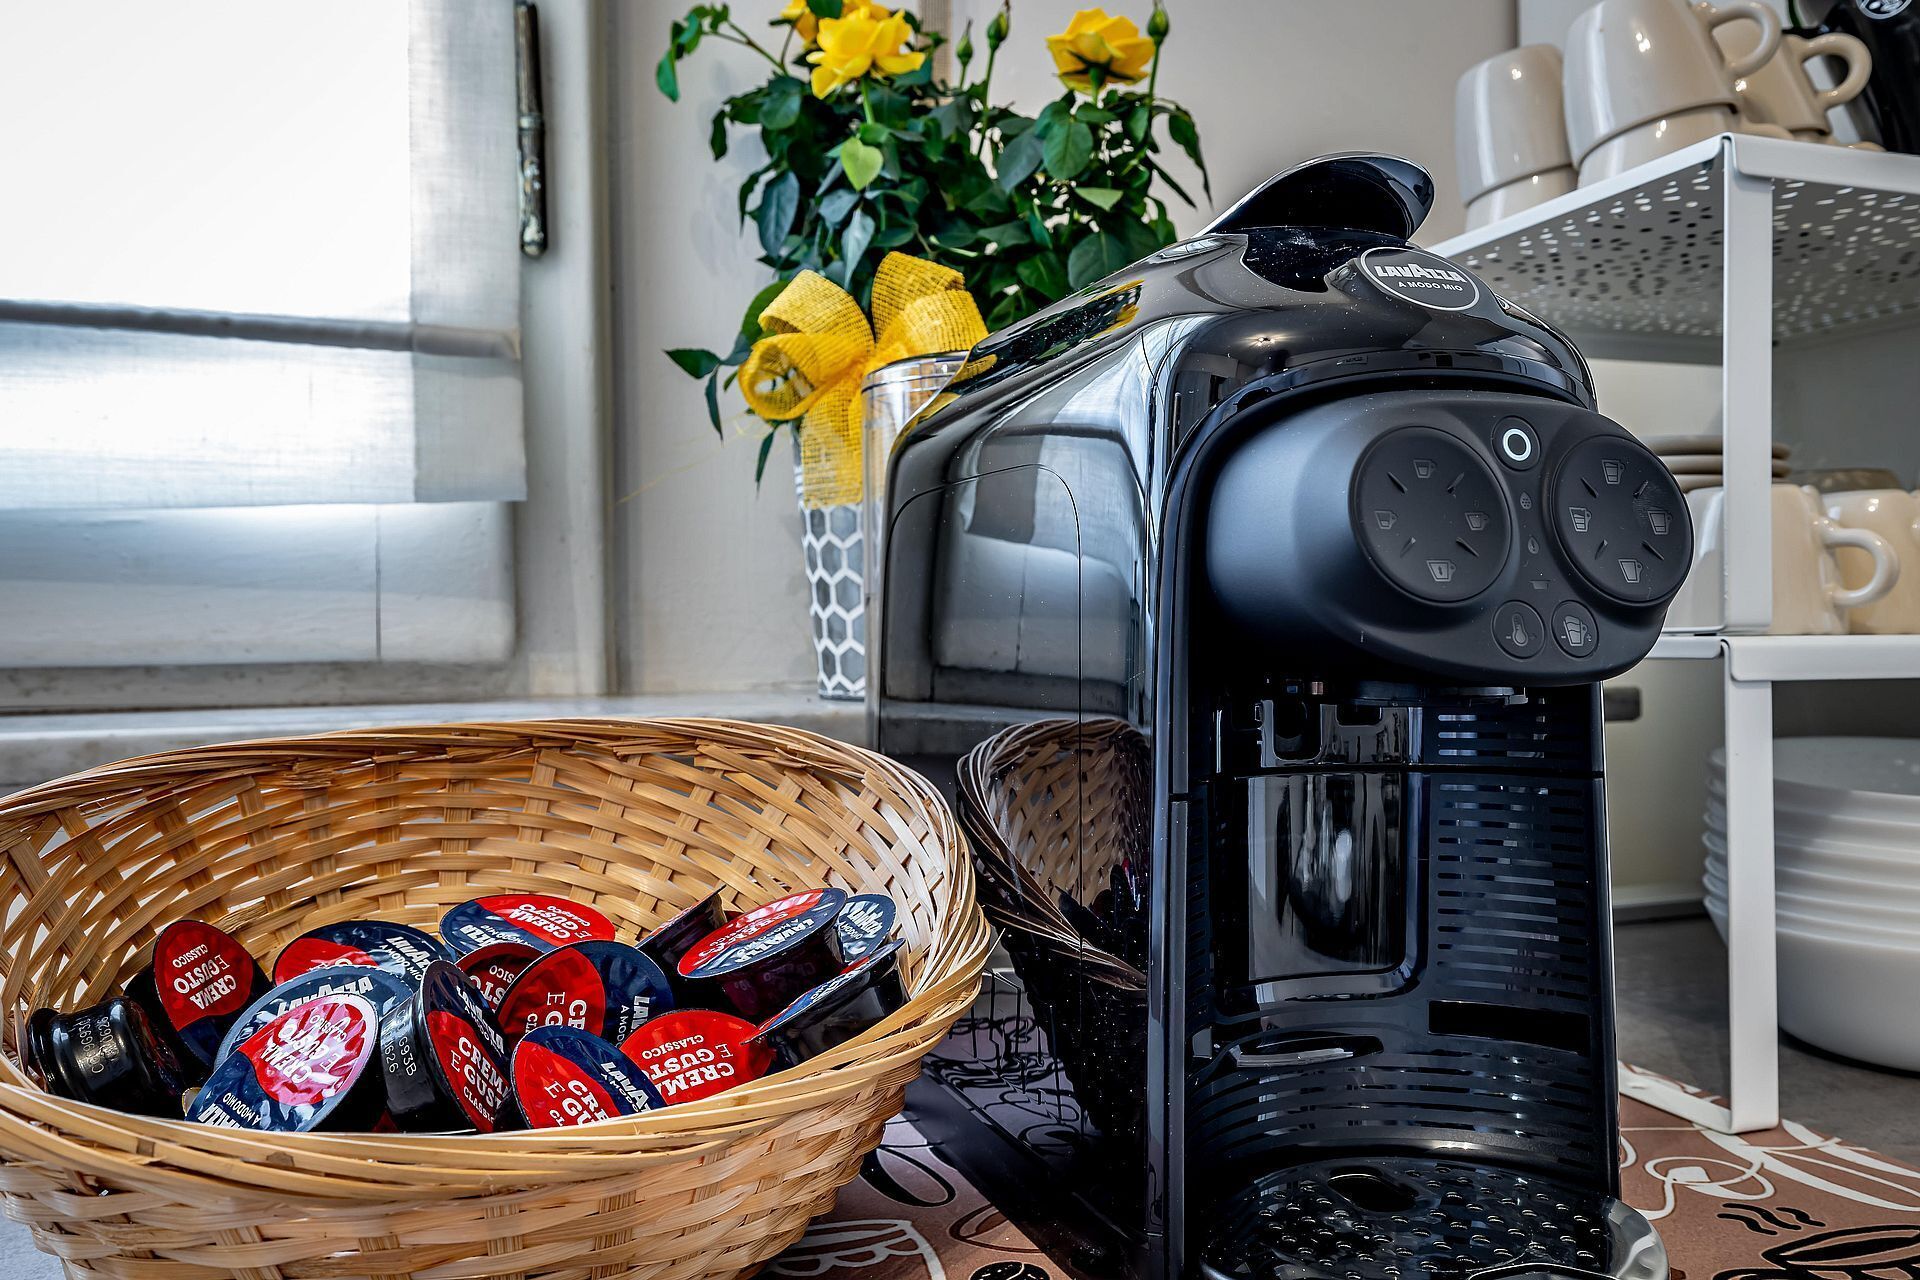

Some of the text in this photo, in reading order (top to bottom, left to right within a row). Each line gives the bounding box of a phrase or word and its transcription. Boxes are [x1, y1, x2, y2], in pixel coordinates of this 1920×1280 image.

[1374, 263, 1467, 283] LAVAZZA
[1408, 281, 1440, 290] MODO
[1441, 283, 1464, 292] MIO
[509, 909, 571, 939] CREMA
[519, 903, 579, 930] GUSTO
[386, 936, 432, 971] LAVAZ
[734, 918, 815, 963] LAVAZZA
[172, 944, 208, 968] CLASSICO
[173, 954, 231, 994] E GUSTO
[489, 964, 515, 984] SICO
[189, 974, 237, 1010] CREMA
[546, 992, 566, 1006] E
[641, 1034, 705, 1060] CLASSICO
[715, 1043, 734, 1058] E
[260, 1042, 313, 1084] CREMA
[450, 1049, 502, 1110] E GUST
[543, 1080, 566, 1099] E
[463, 1086, 495, 1124] CLASSIC
[567, 1079, 610, 1123] CRE
[609, 1080, 639, 1113] MODO
[232, 1100, 256, 1122] MODO
